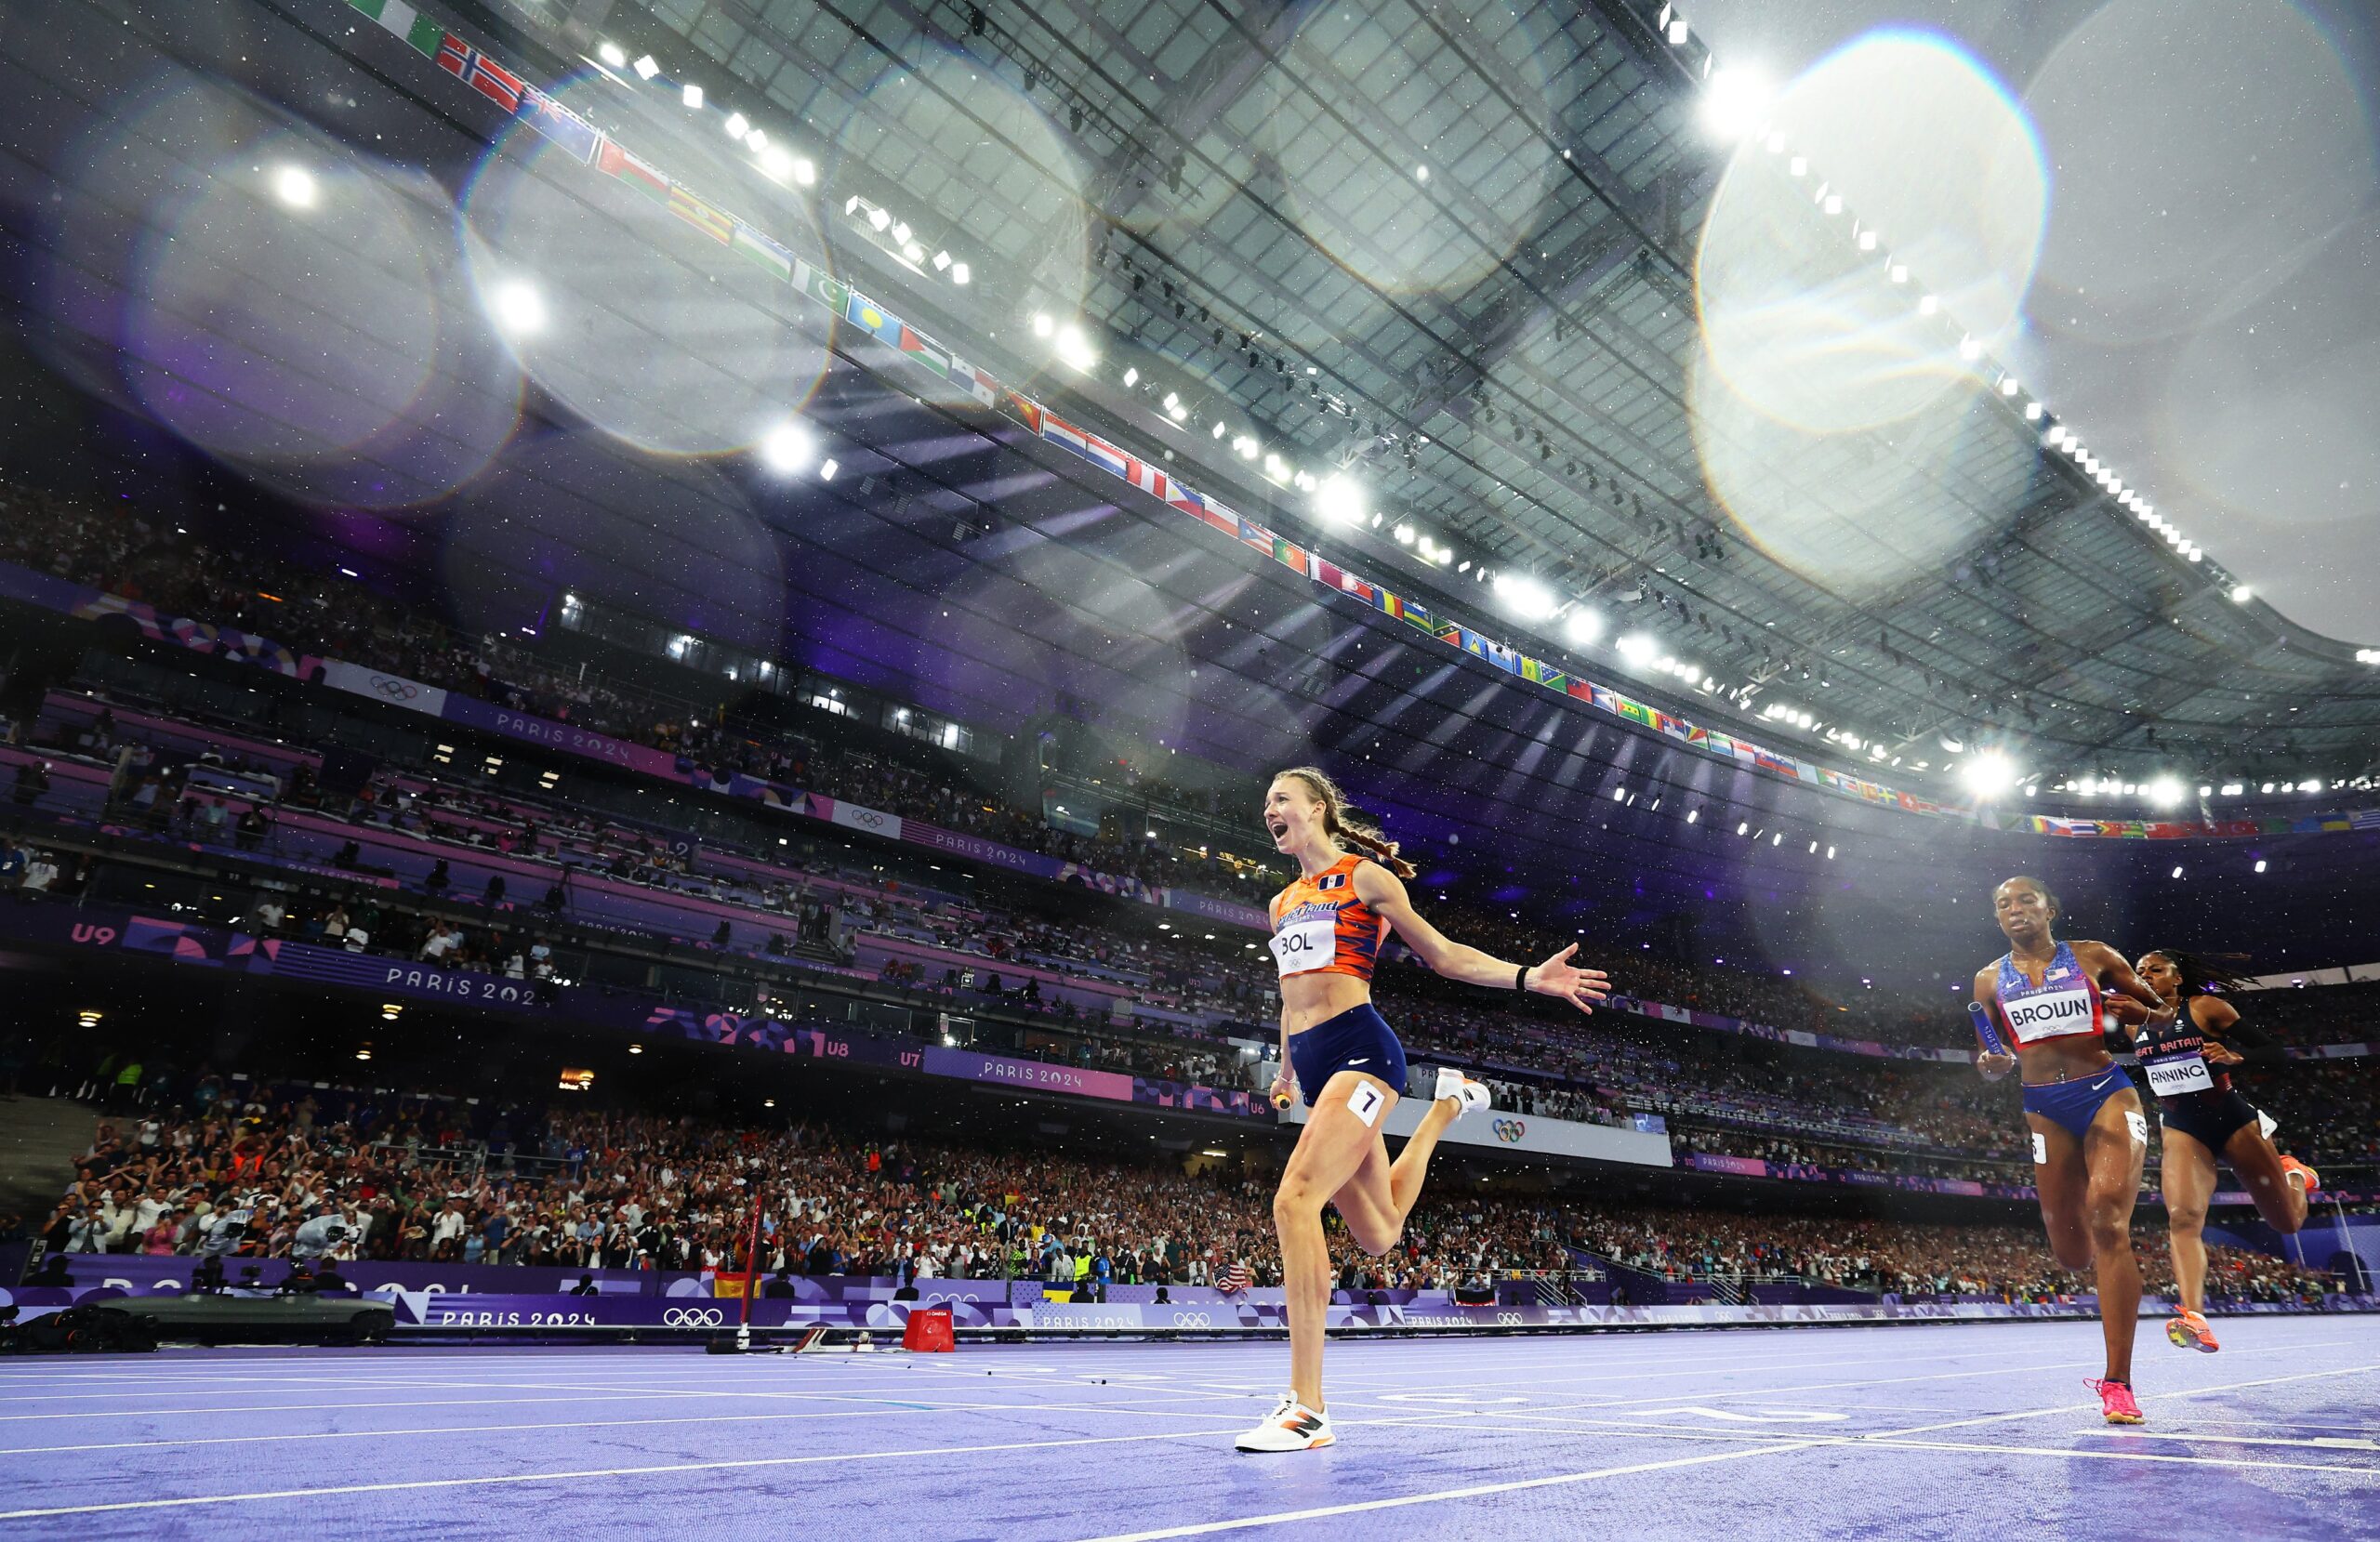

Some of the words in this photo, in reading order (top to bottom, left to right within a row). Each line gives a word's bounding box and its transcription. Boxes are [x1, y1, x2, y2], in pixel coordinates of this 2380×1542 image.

[497, 714, 564, 743] PARIS
[573, 734, 628, 759] 2024
[936, 834, 981, 854] PARIS
[986, 846, 1026, 866] 2024
[1199, 901, 1235, 917] PARIS
[1238, 911, 1268, 926] 2024
[72, 923, 115, 945] U9
[1282, 933, 1313, 956] BOL
[387, 969, 471, 995] PARIS
[482, 983, 550, 1008] 202
[2011, 999, 2088, 1026] BROWN
[826, 1041, 849, 1057] U8
[2160, 1036, 2204, 1052] BRITAIN
[900, 1051, 920, 1068] U7
[985, 1061, 1033, 1080] PARIS
[1040, 1070, 1081, 1087] 2024
[2150, 1065, 2204, 1084] ANNING
[1250, 1102, 1265, 1114] U6
[1362, 1090, 1376, 1113] 7
[1702, 1157, 1725, 1167] PARIS
[442, 1311, 520, 1326] PARIS
[531, 1312, 596, 1326] 2024
[1043, 1316, 1089, 1327] PARIS
[1094, 1316, 1134, 1327] 2024
[1411, 1316, 1443, 1325] PARIS
[1445, 1316, 1473, 1325] 2024
